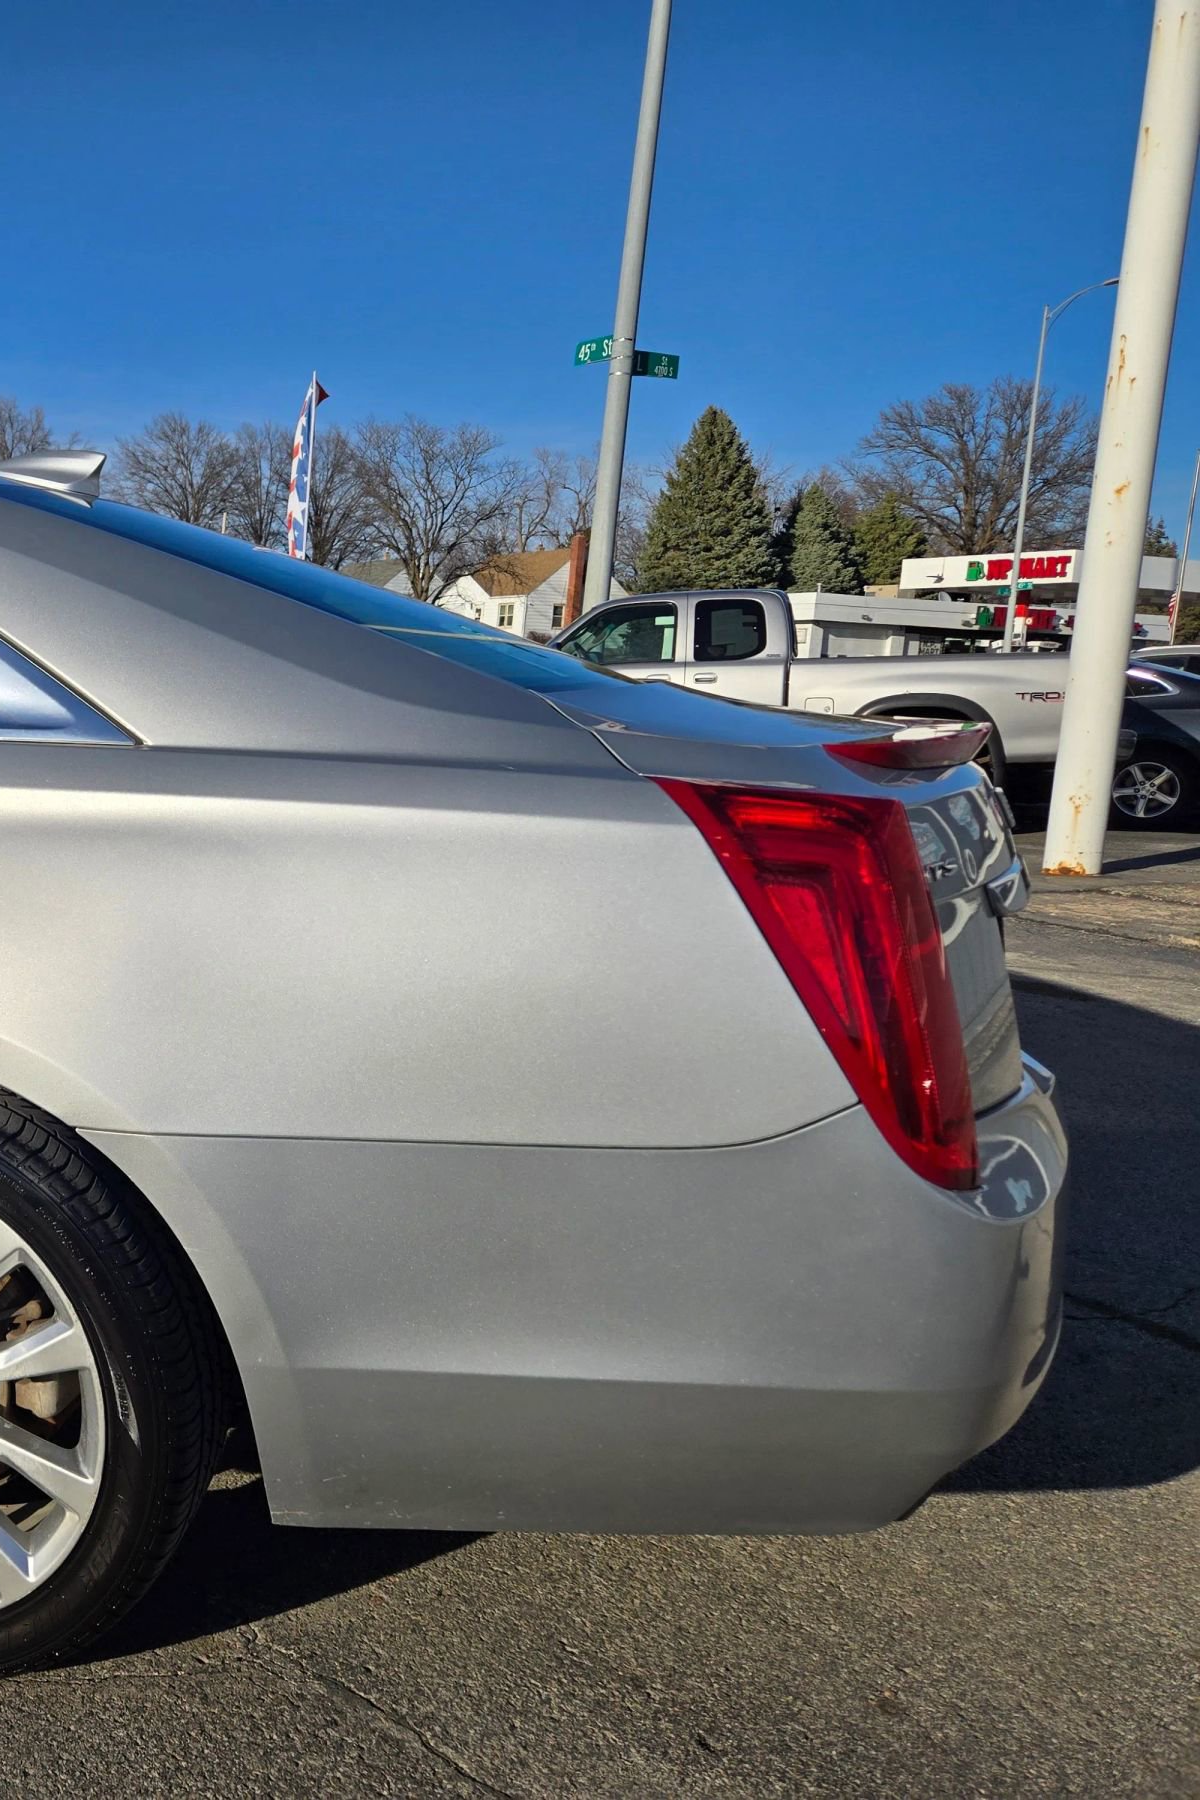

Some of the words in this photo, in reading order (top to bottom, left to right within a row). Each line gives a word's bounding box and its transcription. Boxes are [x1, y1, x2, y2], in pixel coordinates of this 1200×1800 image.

[578, 343, 596, 361] 45th
[602, 339, 612, 357] St
[1017, 556, 1072, 580] MART
[1015, 691, 1060, 703] TRD
